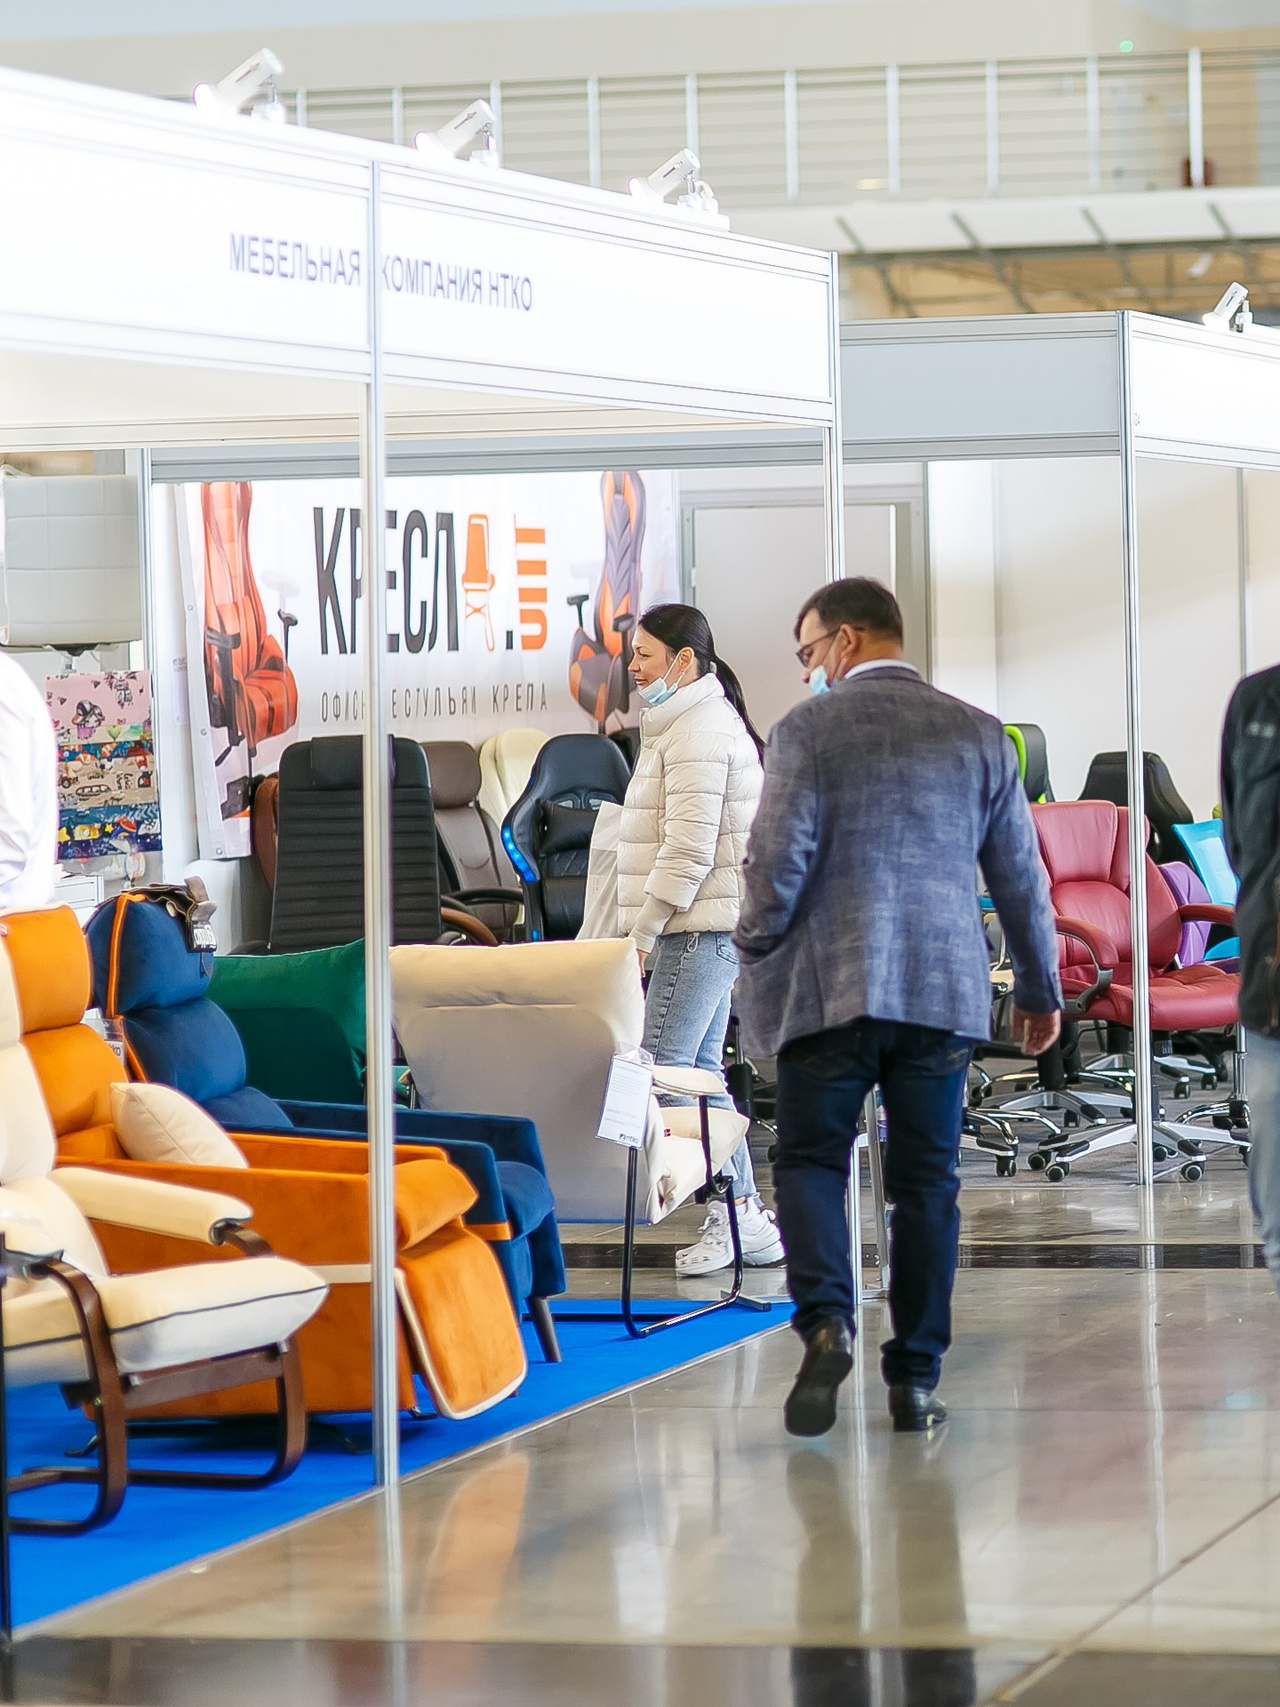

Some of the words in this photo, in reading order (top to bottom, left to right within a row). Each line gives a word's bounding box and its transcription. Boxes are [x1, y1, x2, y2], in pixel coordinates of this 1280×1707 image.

[230, 232, 361, 287] МЕБЕЛЬНАЯ
[382, 254, 483, 304] КОМПАНИЯ
[489, 270, 534, 312] НТКО
